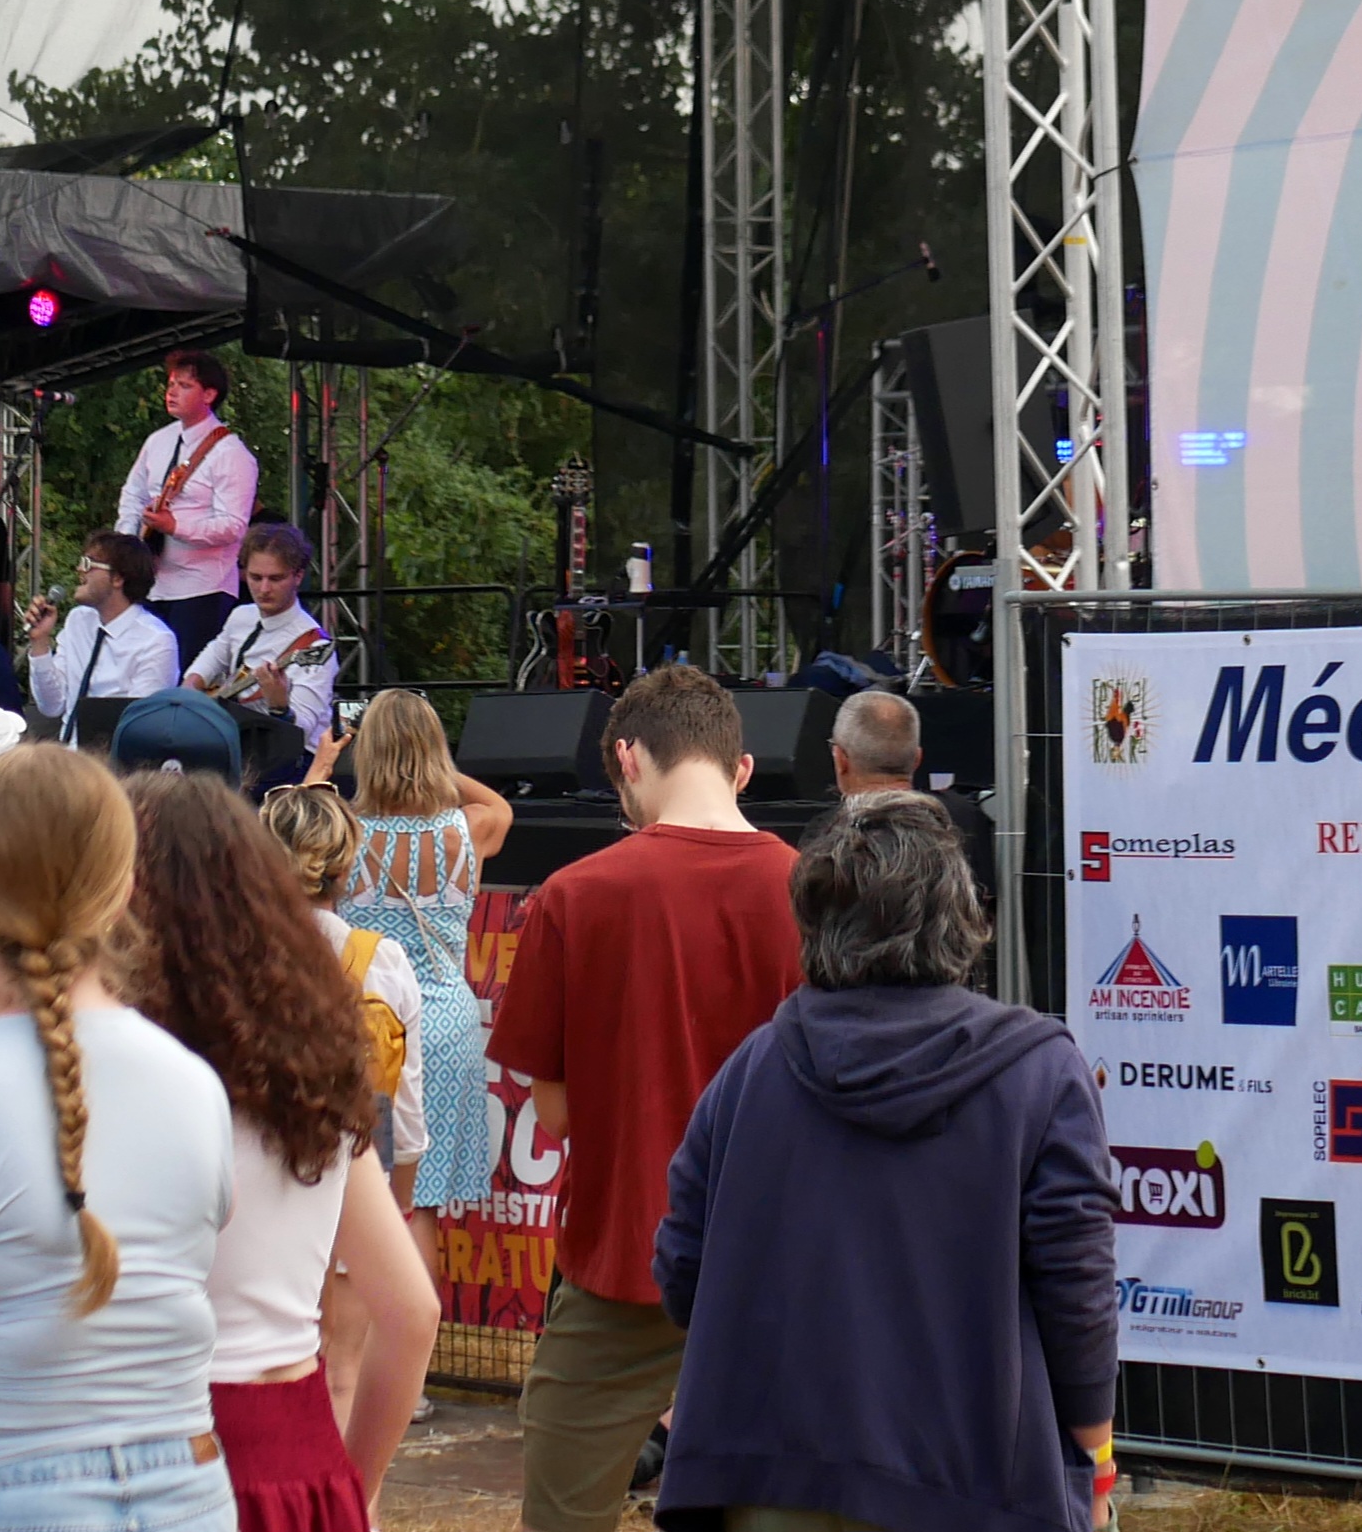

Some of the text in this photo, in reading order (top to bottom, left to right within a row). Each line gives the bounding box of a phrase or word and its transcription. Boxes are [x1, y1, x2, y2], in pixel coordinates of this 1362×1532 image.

[1089, 990, 1112, 1008] AM
[1095, 1010, 1184, 1022] artisan sprinklers
[1120, 1062, 1236, 1091] DERUME
[1247, 1079, 1273, 1093] FILS
[1312, 1080, 1327, 1161] SOPELEC
